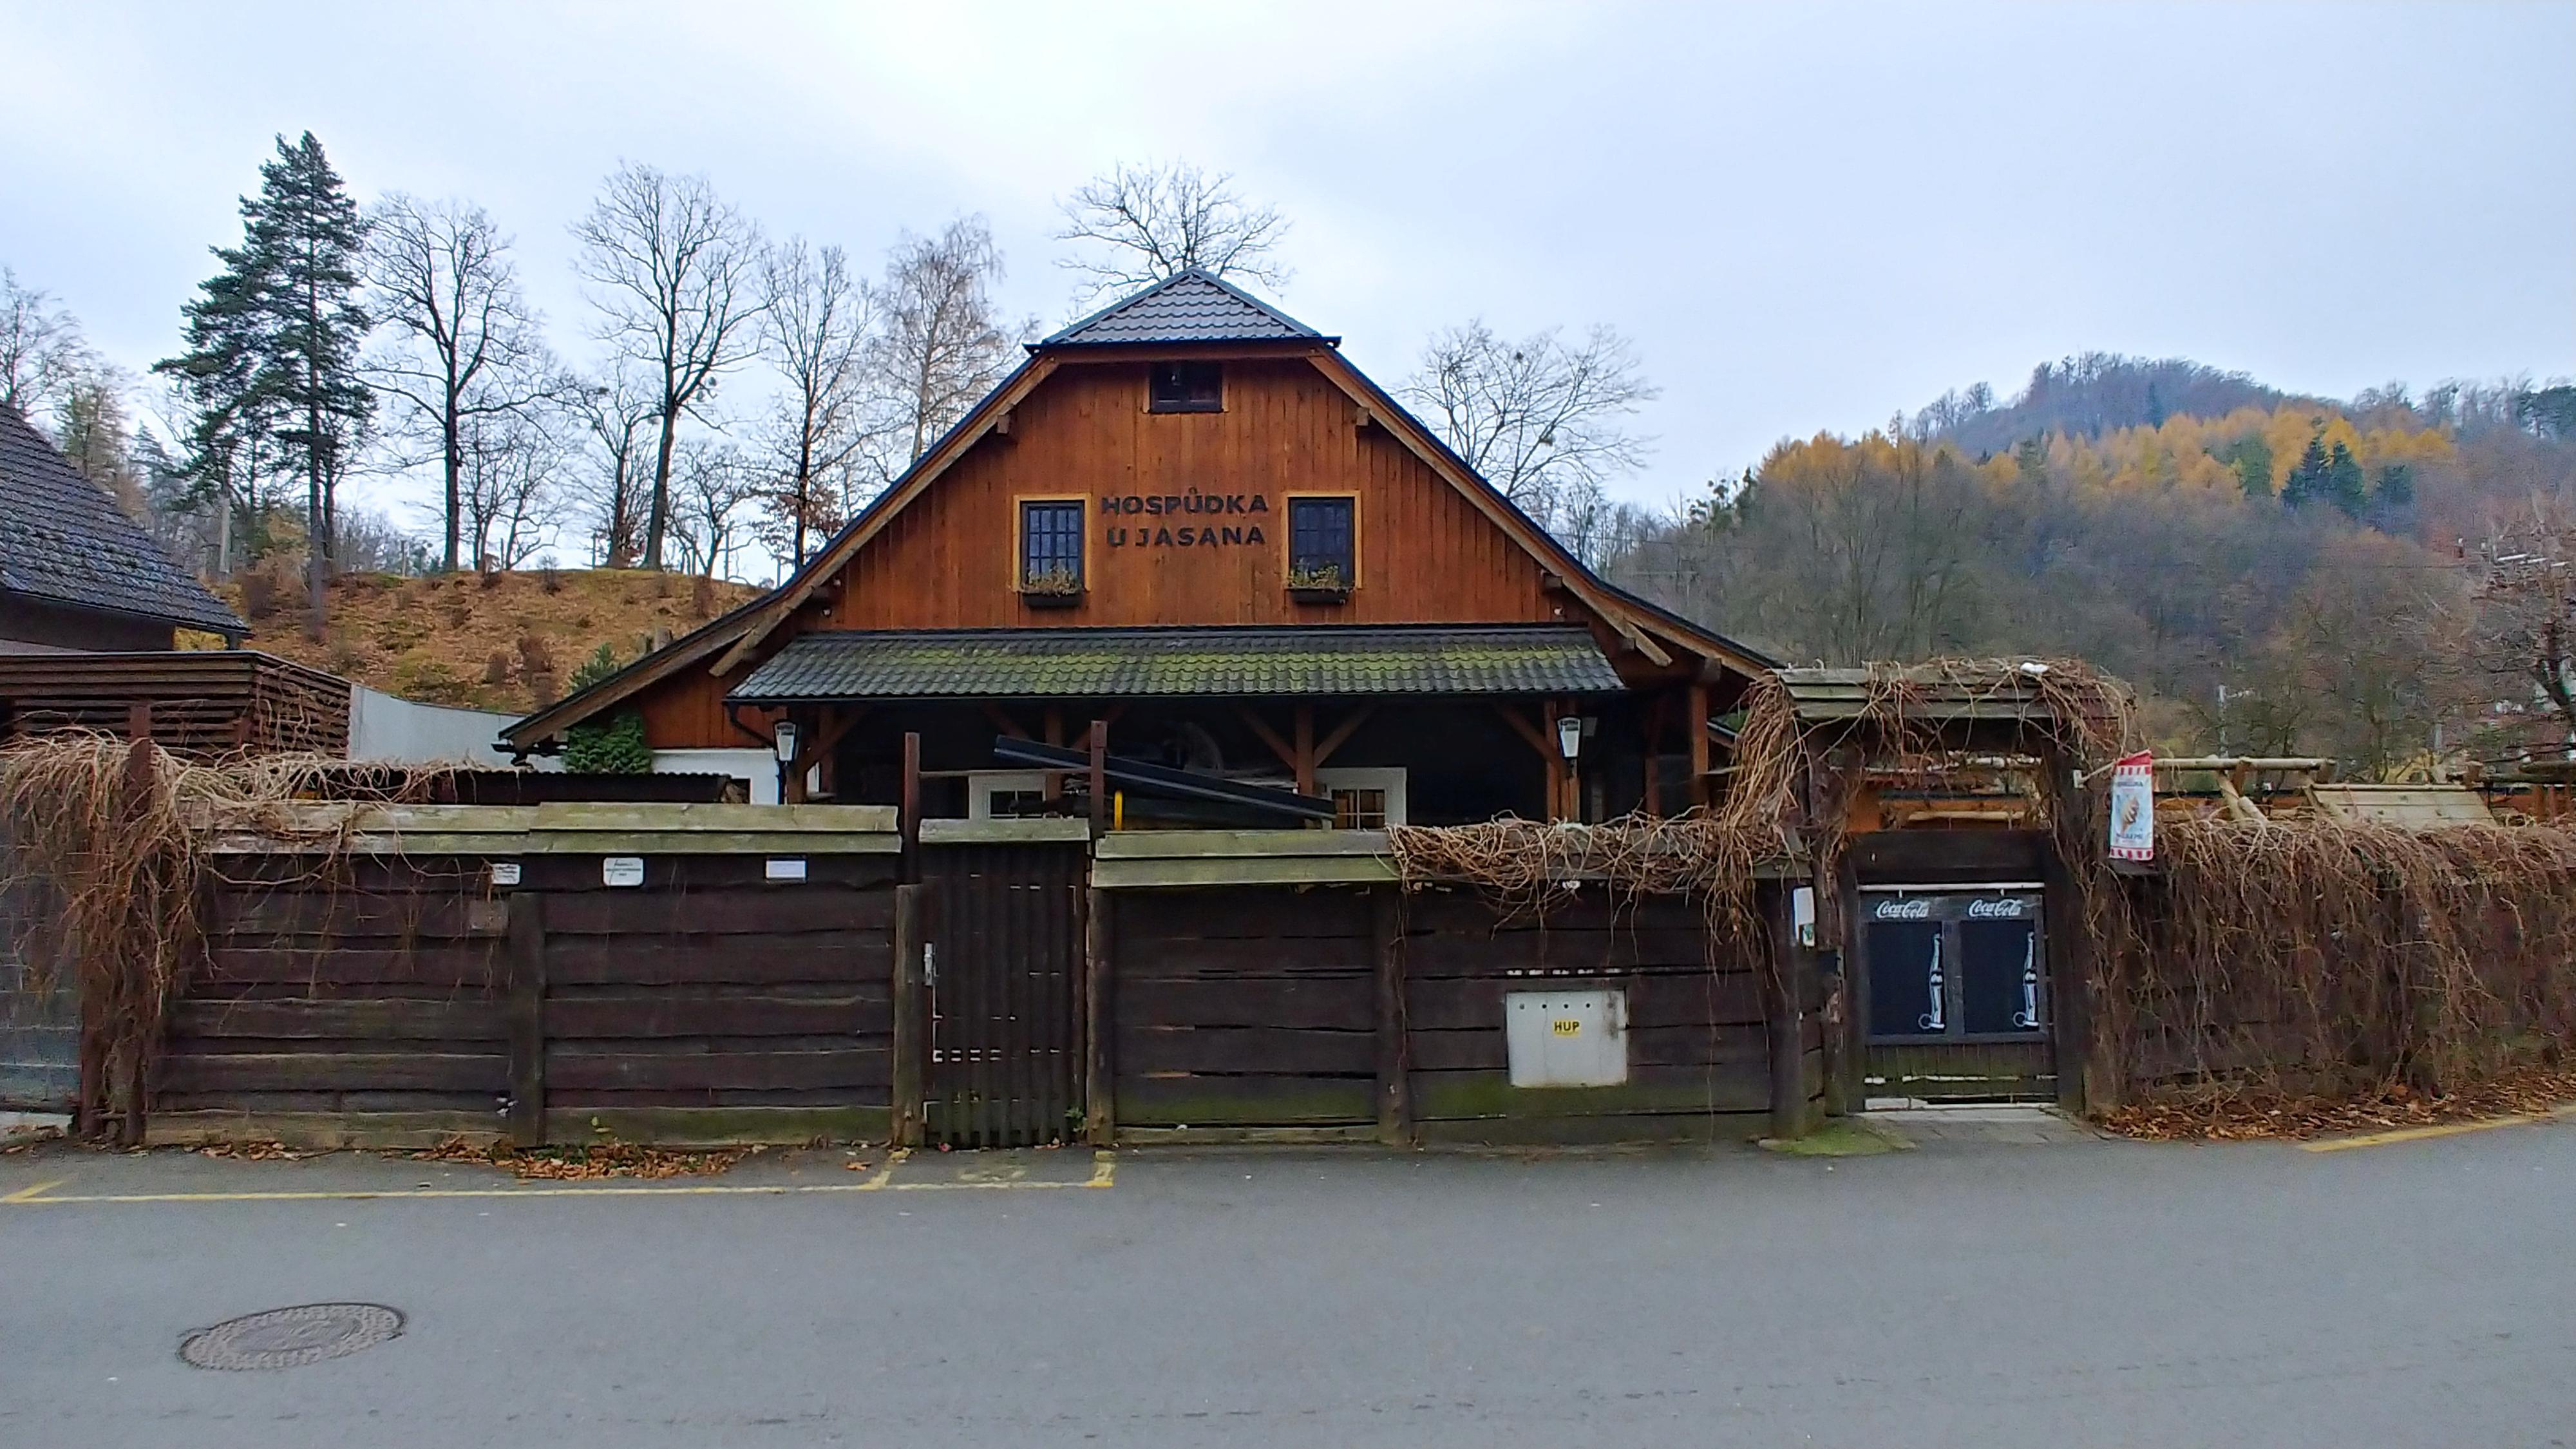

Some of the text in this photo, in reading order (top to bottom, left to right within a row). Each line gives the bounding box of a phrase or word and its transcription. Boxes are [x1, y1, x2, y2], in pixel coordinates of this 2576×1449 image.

[1102, 486, 1268, 515] HOSPŮDKA
[1106, 526, 1265, 547] U JASANA
[1554, 1021, 1580, 1032] HUP
